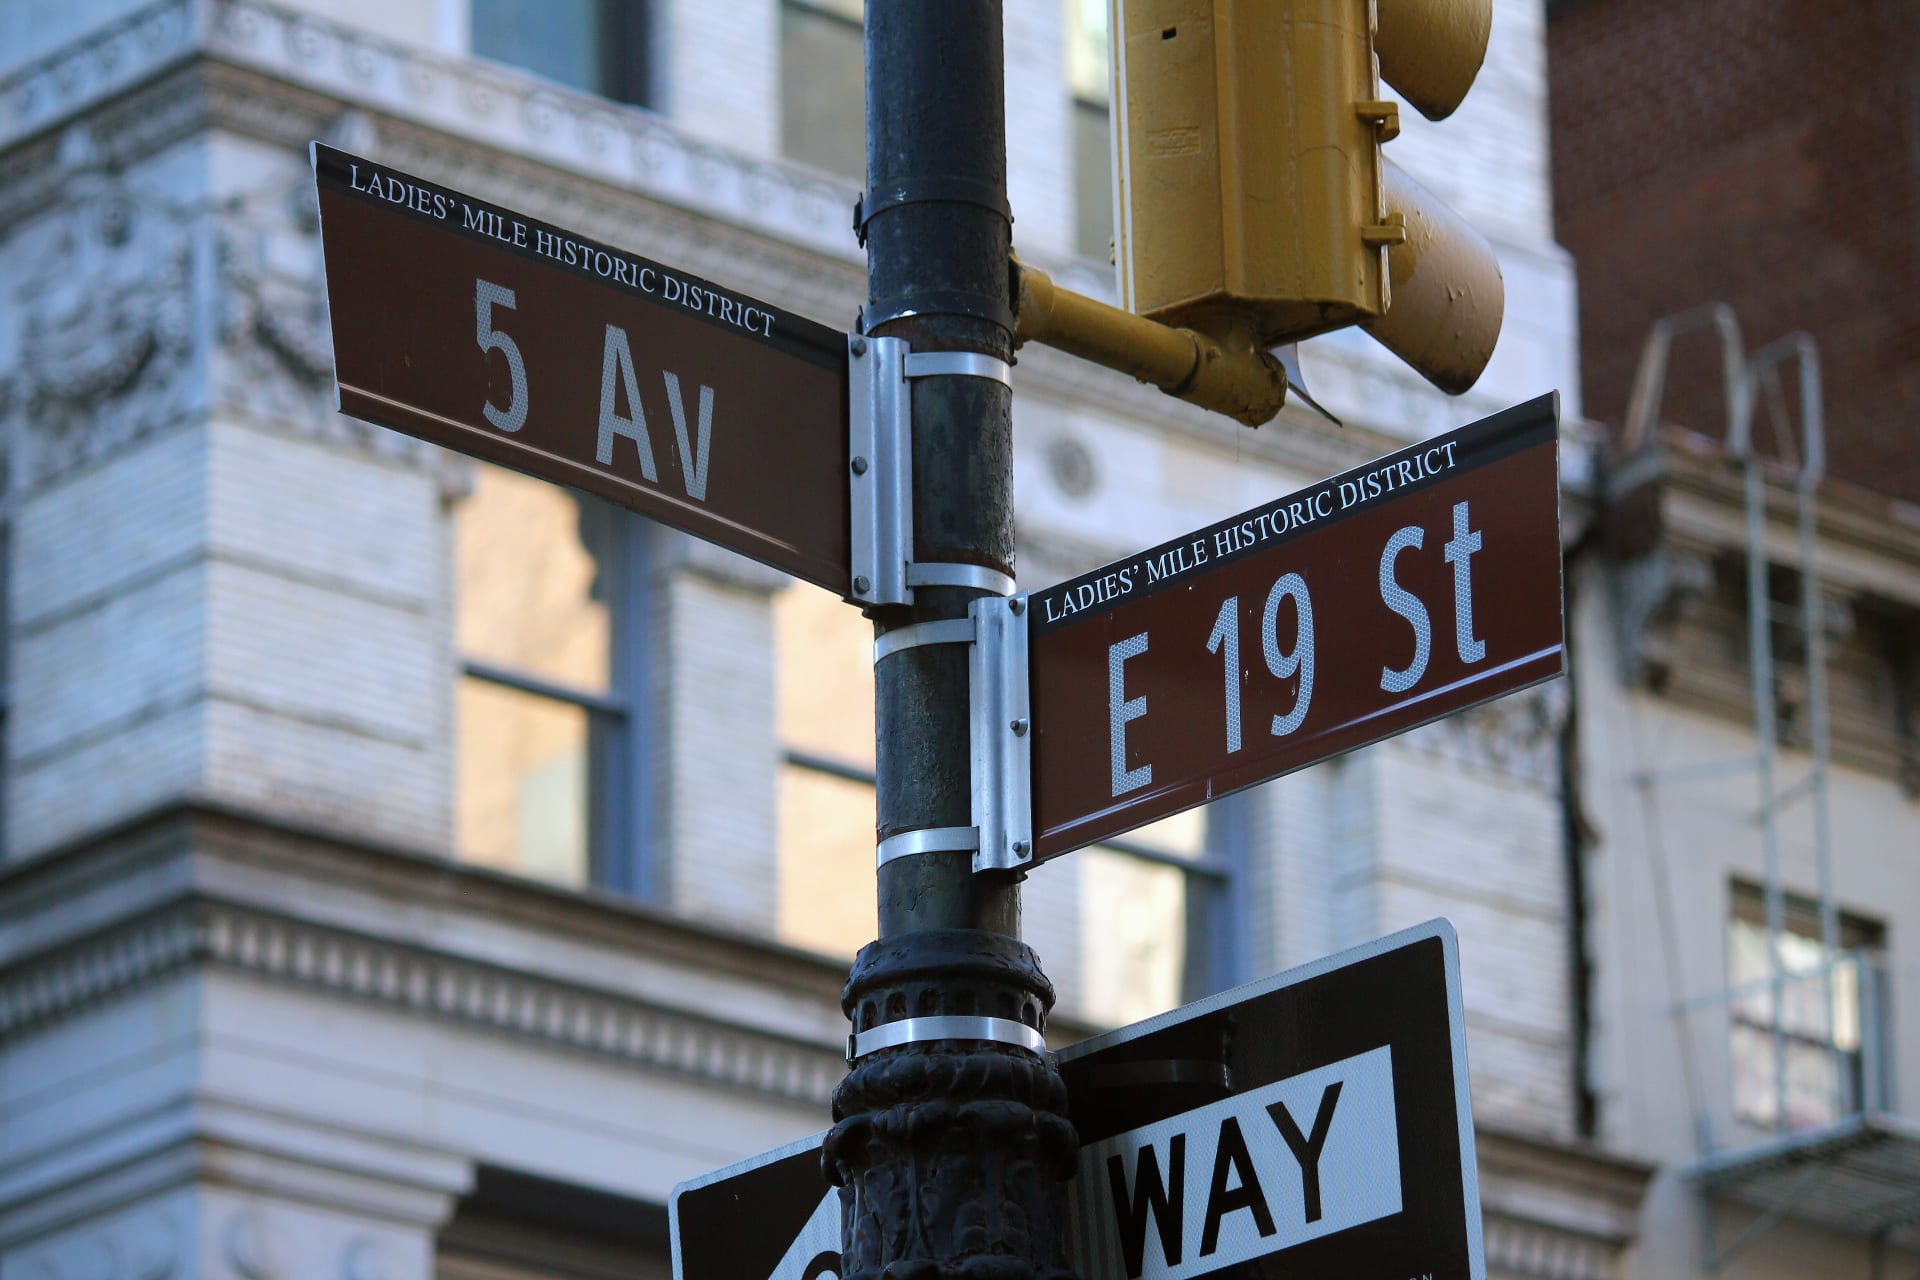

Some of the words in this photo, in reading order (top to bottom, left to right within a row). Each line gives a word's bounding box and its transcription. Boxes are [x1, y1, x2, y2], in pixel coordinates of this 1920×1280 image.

[350, 163, 455, 220] LADIES'
[462, 203, 528, 249] MILE
[535, 229, 656, 293] HISTORIC
[662, 273, 776, 338] DISTRICT
[474, 277, 530, 434] 5
[1044, 563, 1139, 624] LADIES'
[1145, 538, 1209, 585] MILE
[1213, 489, 1334, 559] HISTORIC
[1338, 440, 1458, 511] DISTRICT
[1108, 631, 1153, 797] E
[1206, 571, 1316, 755] 19
[1378, 500, 1488, 694] St
[1106, 1080, 1344, 1280] WAY
